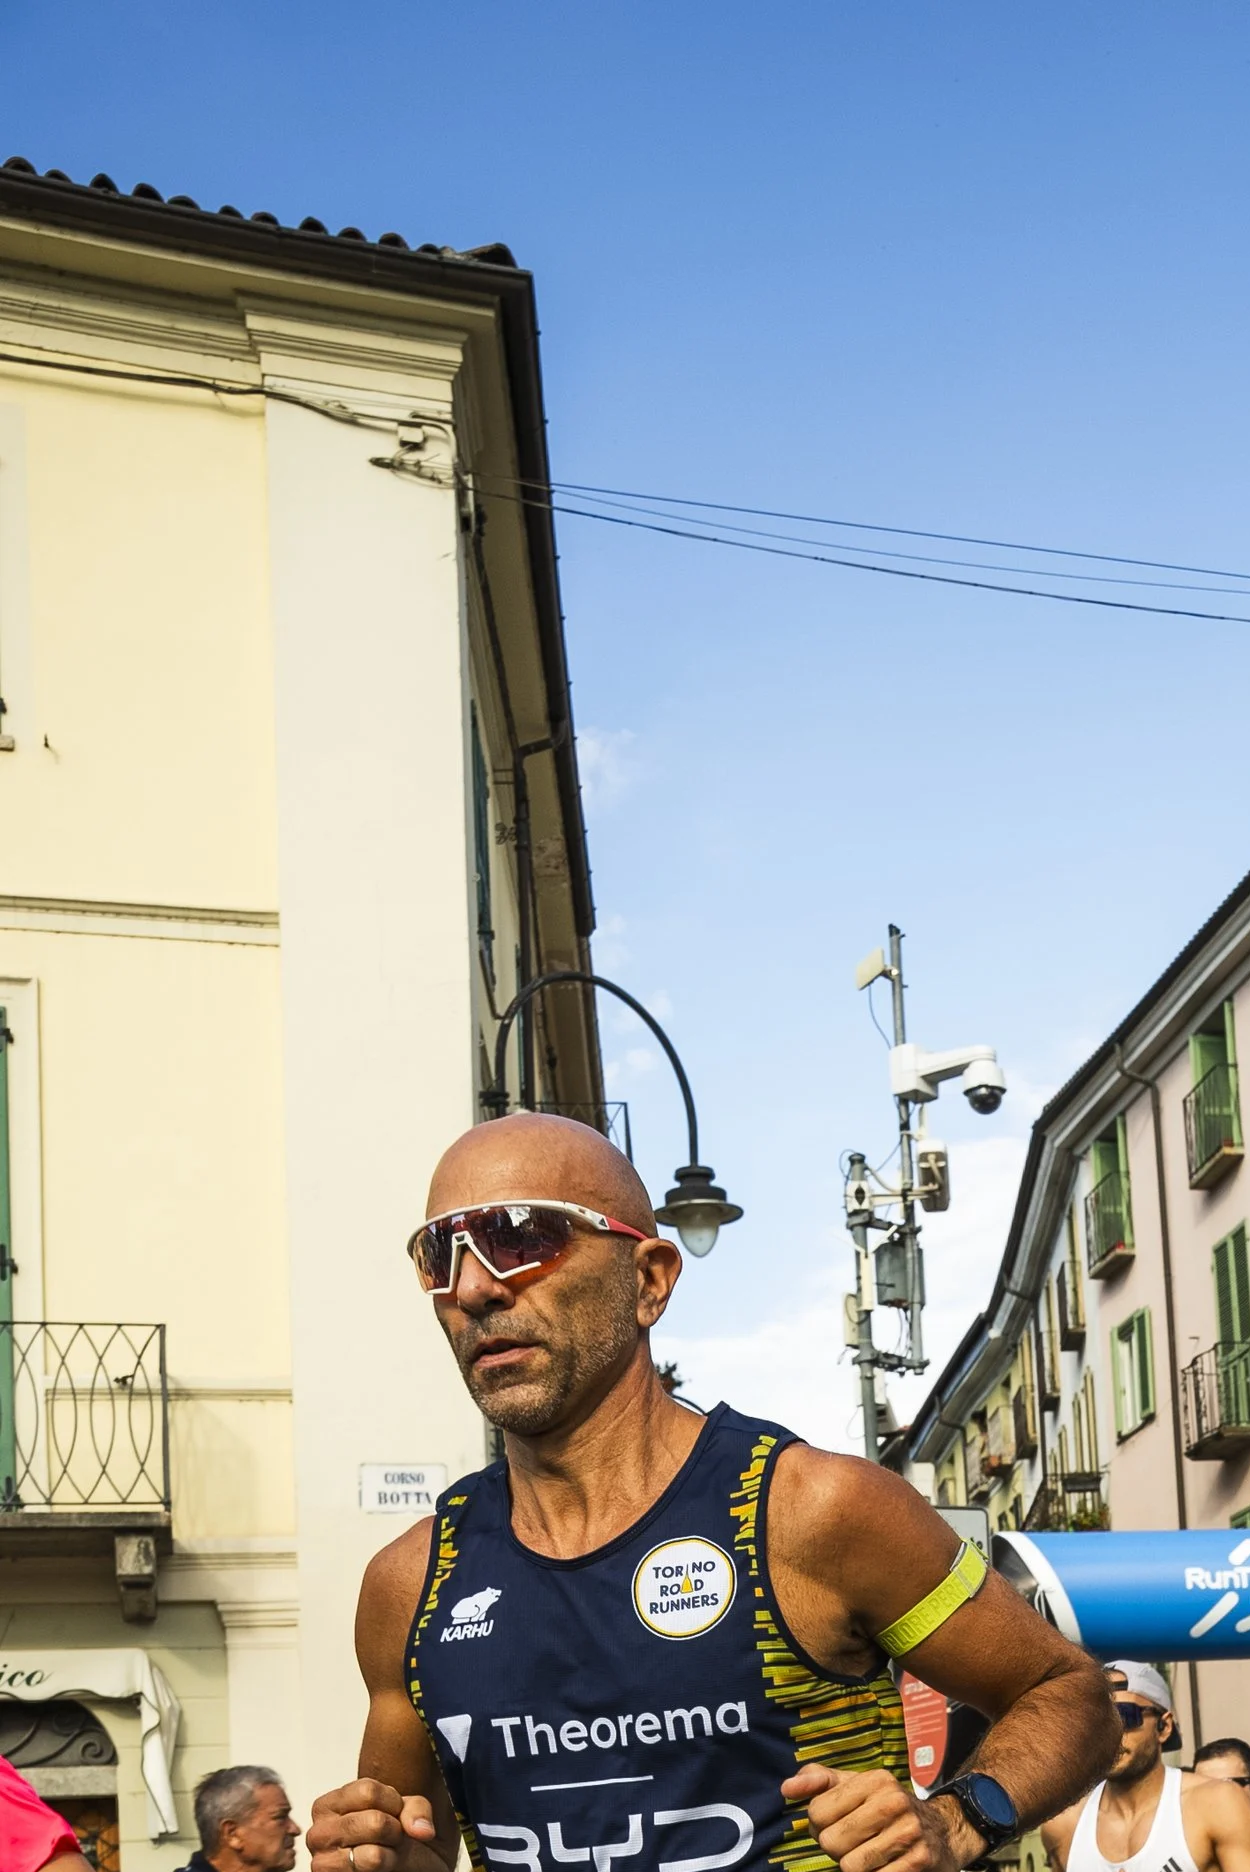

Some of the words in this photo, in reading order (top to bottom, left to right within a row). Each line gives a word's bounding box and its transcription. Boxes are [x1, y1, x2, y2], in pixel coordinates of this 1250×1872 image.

[384, 1472, 425, 1485] CORSO
[378, 1491, 433, 1505] BOTTA
[649, 1593, 719, 1615] RUNNERS
[440, 1619, 495, 1643] KARHU
[491, 1701, 749, 1758] Theorema
